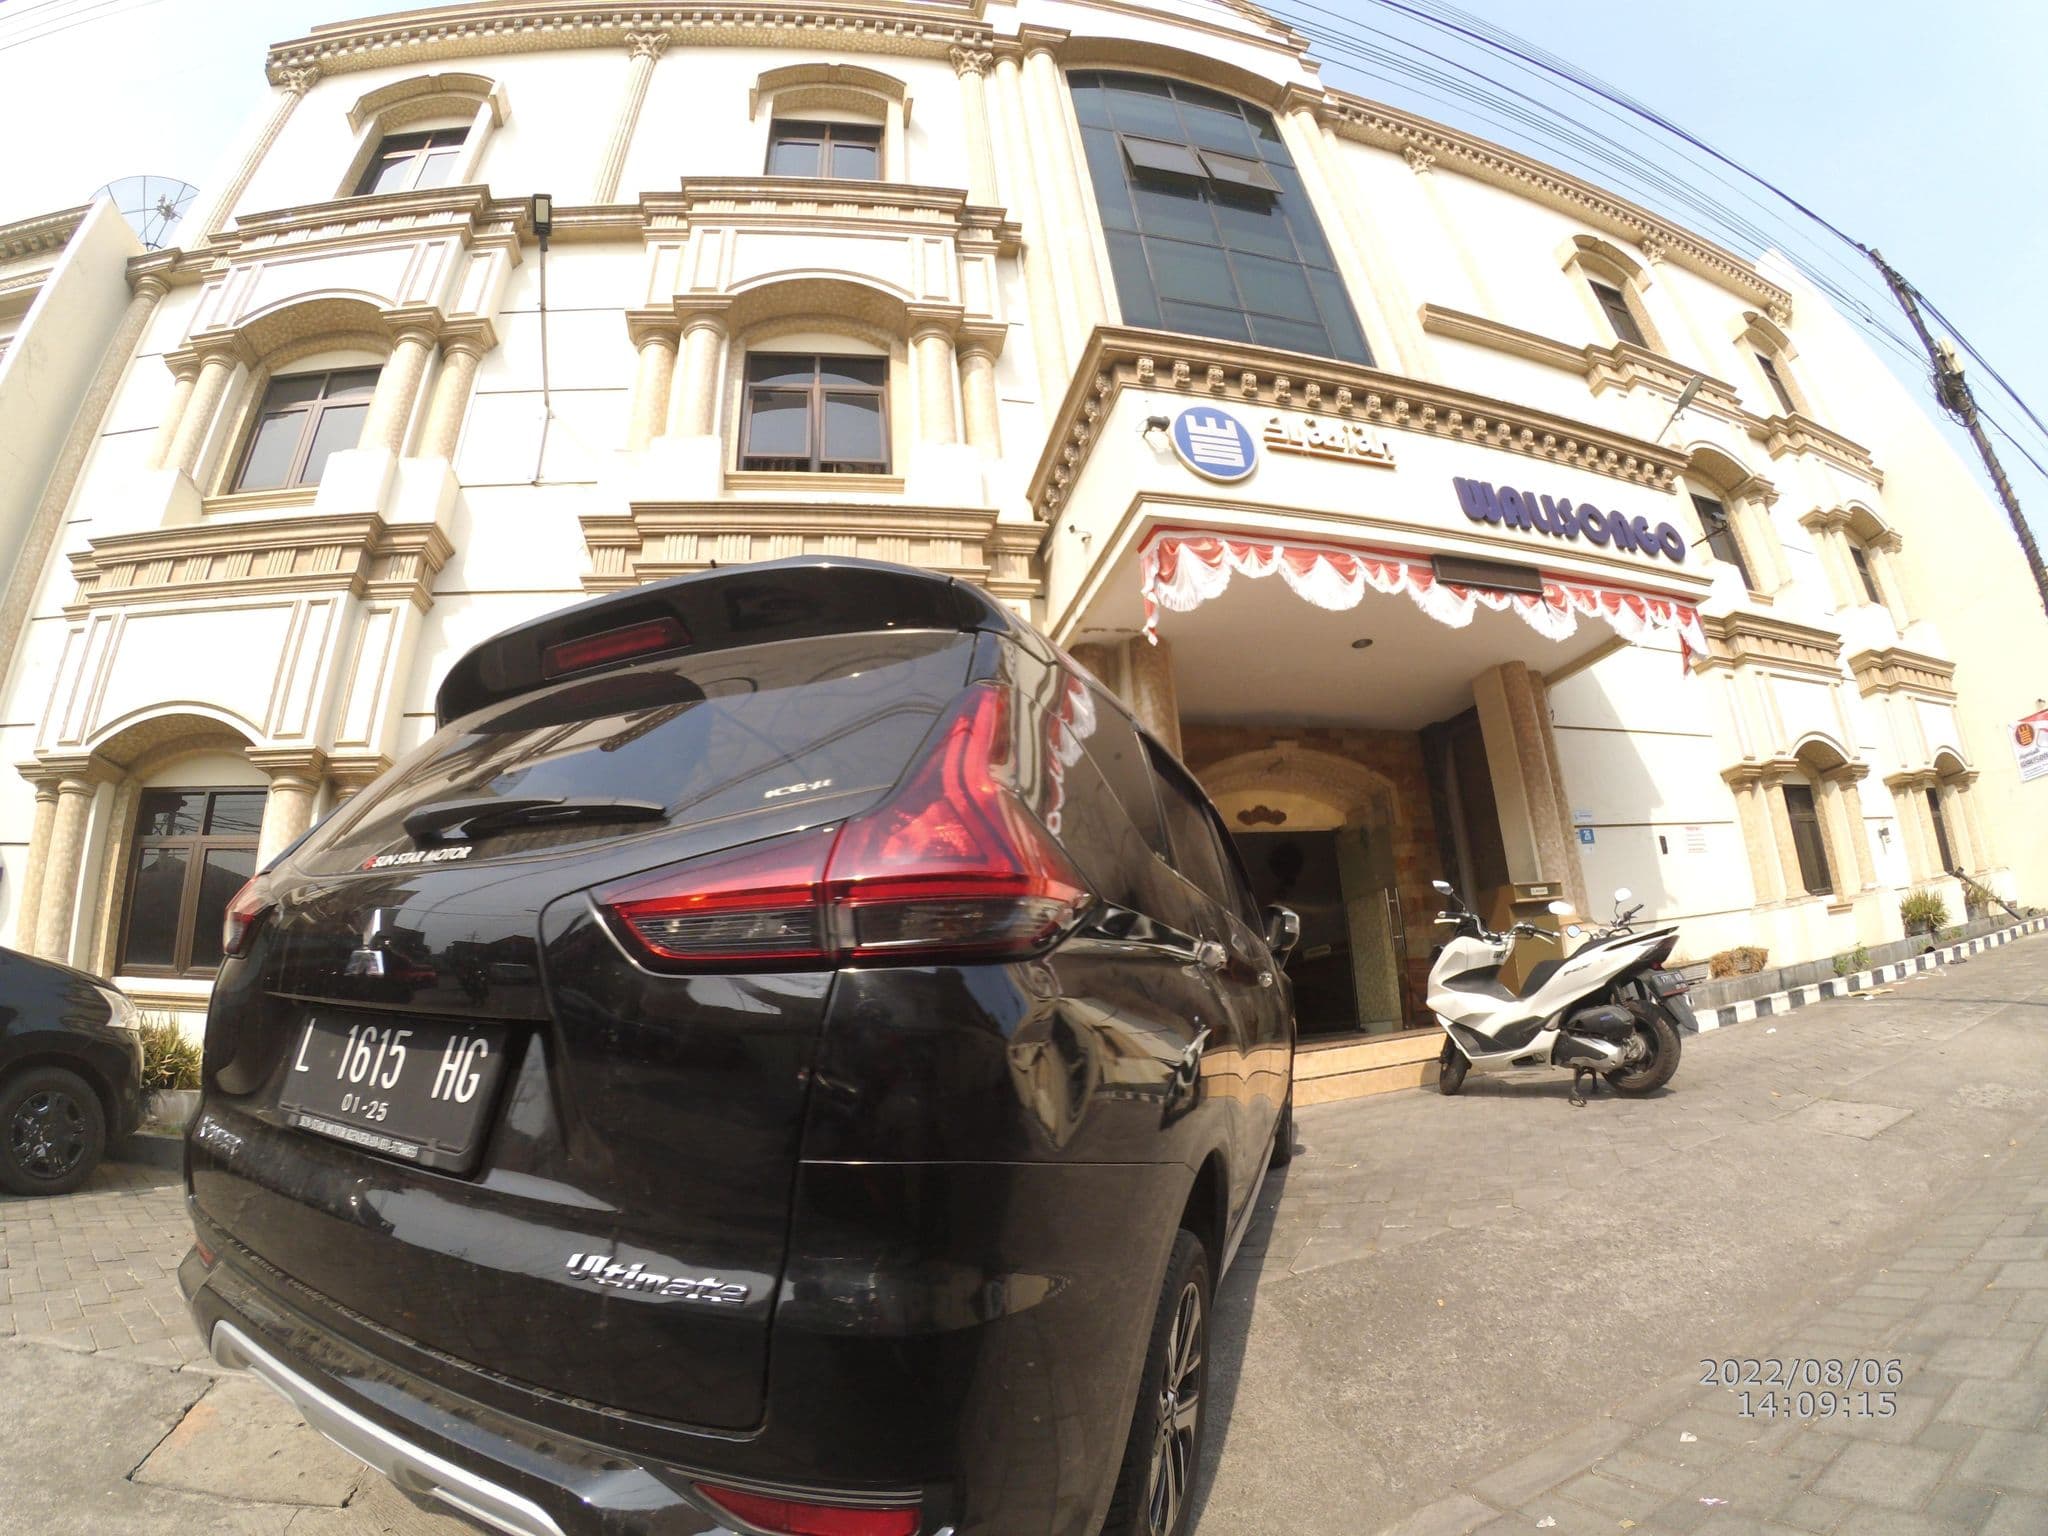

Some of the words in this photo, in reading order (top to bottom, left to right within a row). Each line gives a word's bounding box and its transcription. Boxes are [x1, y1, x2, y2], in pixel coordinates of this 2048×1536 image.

[1452, 476, 1686, 563] WALISONGO
[371, 854, 399, 868] SUN
[394, 850, 426, 865] STAR
[422, 846, 473, 862] MOTOR
[294, 1017, 317, 1073] L
[336, 1023, 415, 1090] 1615
[430, 1034, 490, 1104] HG
[564, 1252, 749, 1303] Ultimate
